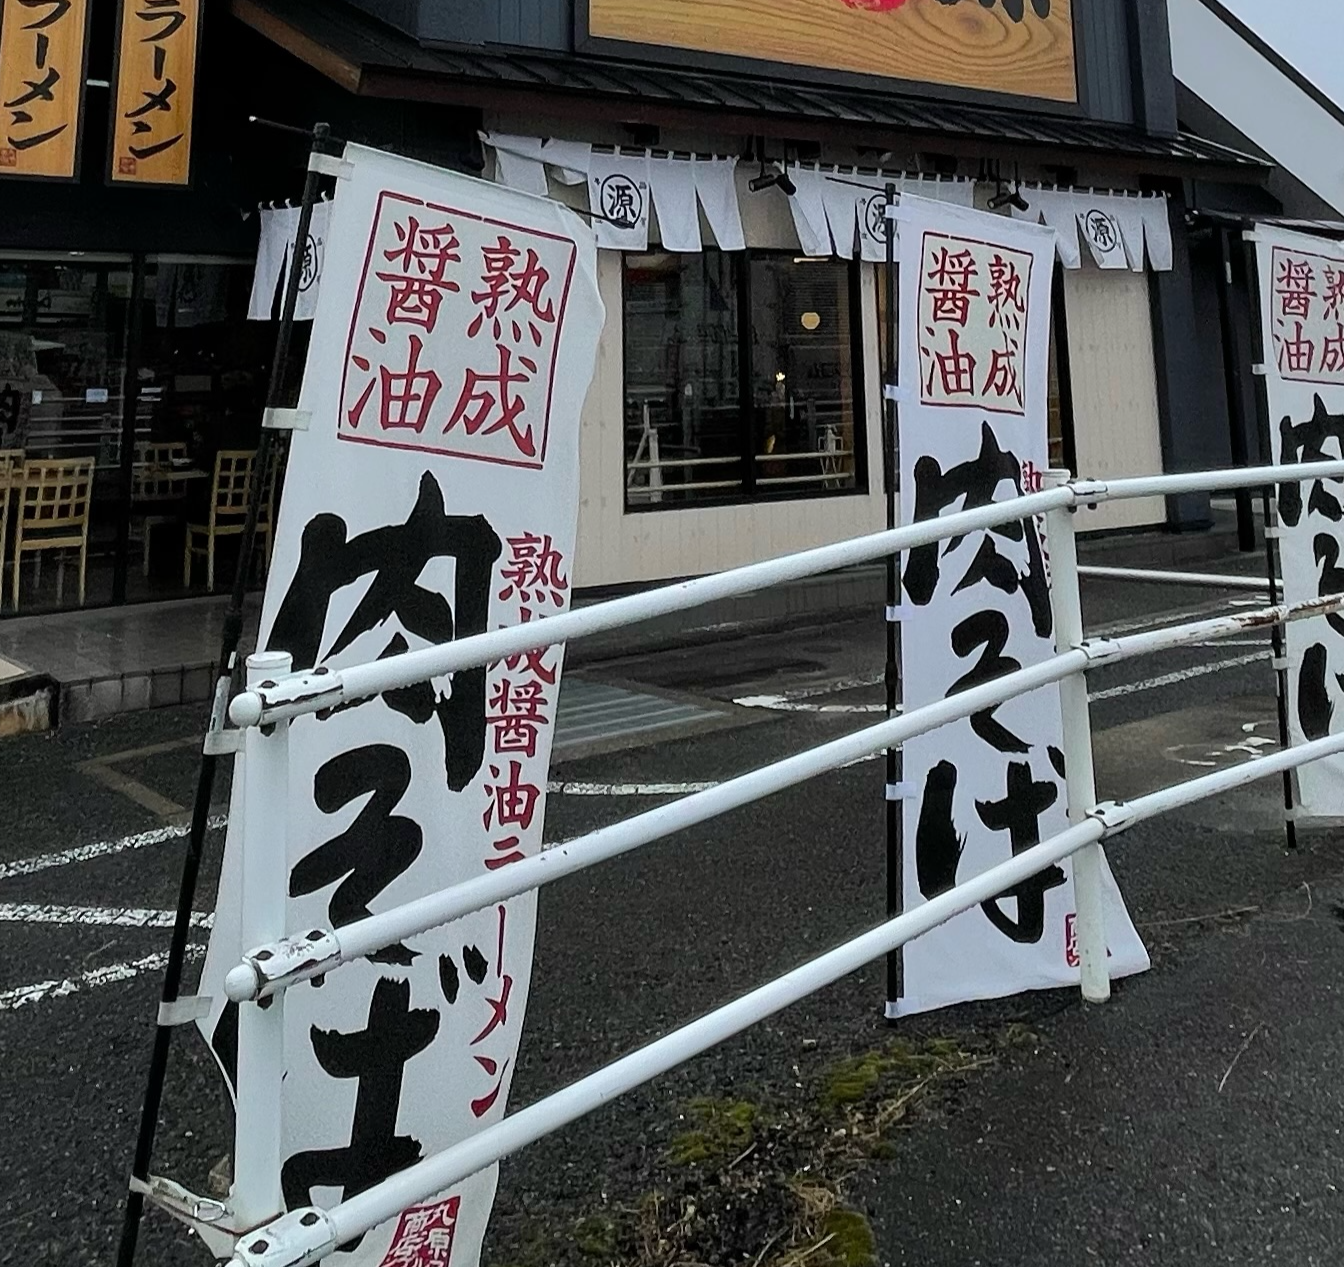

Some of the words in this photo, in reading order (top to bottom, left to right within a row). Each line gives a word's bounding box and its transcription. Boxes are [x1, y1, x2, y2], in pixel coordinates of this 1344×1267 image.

[607, 184, 636, 219] 源
[347, 215, 462, 434] 醤油
[442, 235, 556, 458] 熟成
[921, 247, 980, 398] 醤油
[981, 253, 1026, 410] 熟成
[1274, 258, 1319, 375] 醤油
